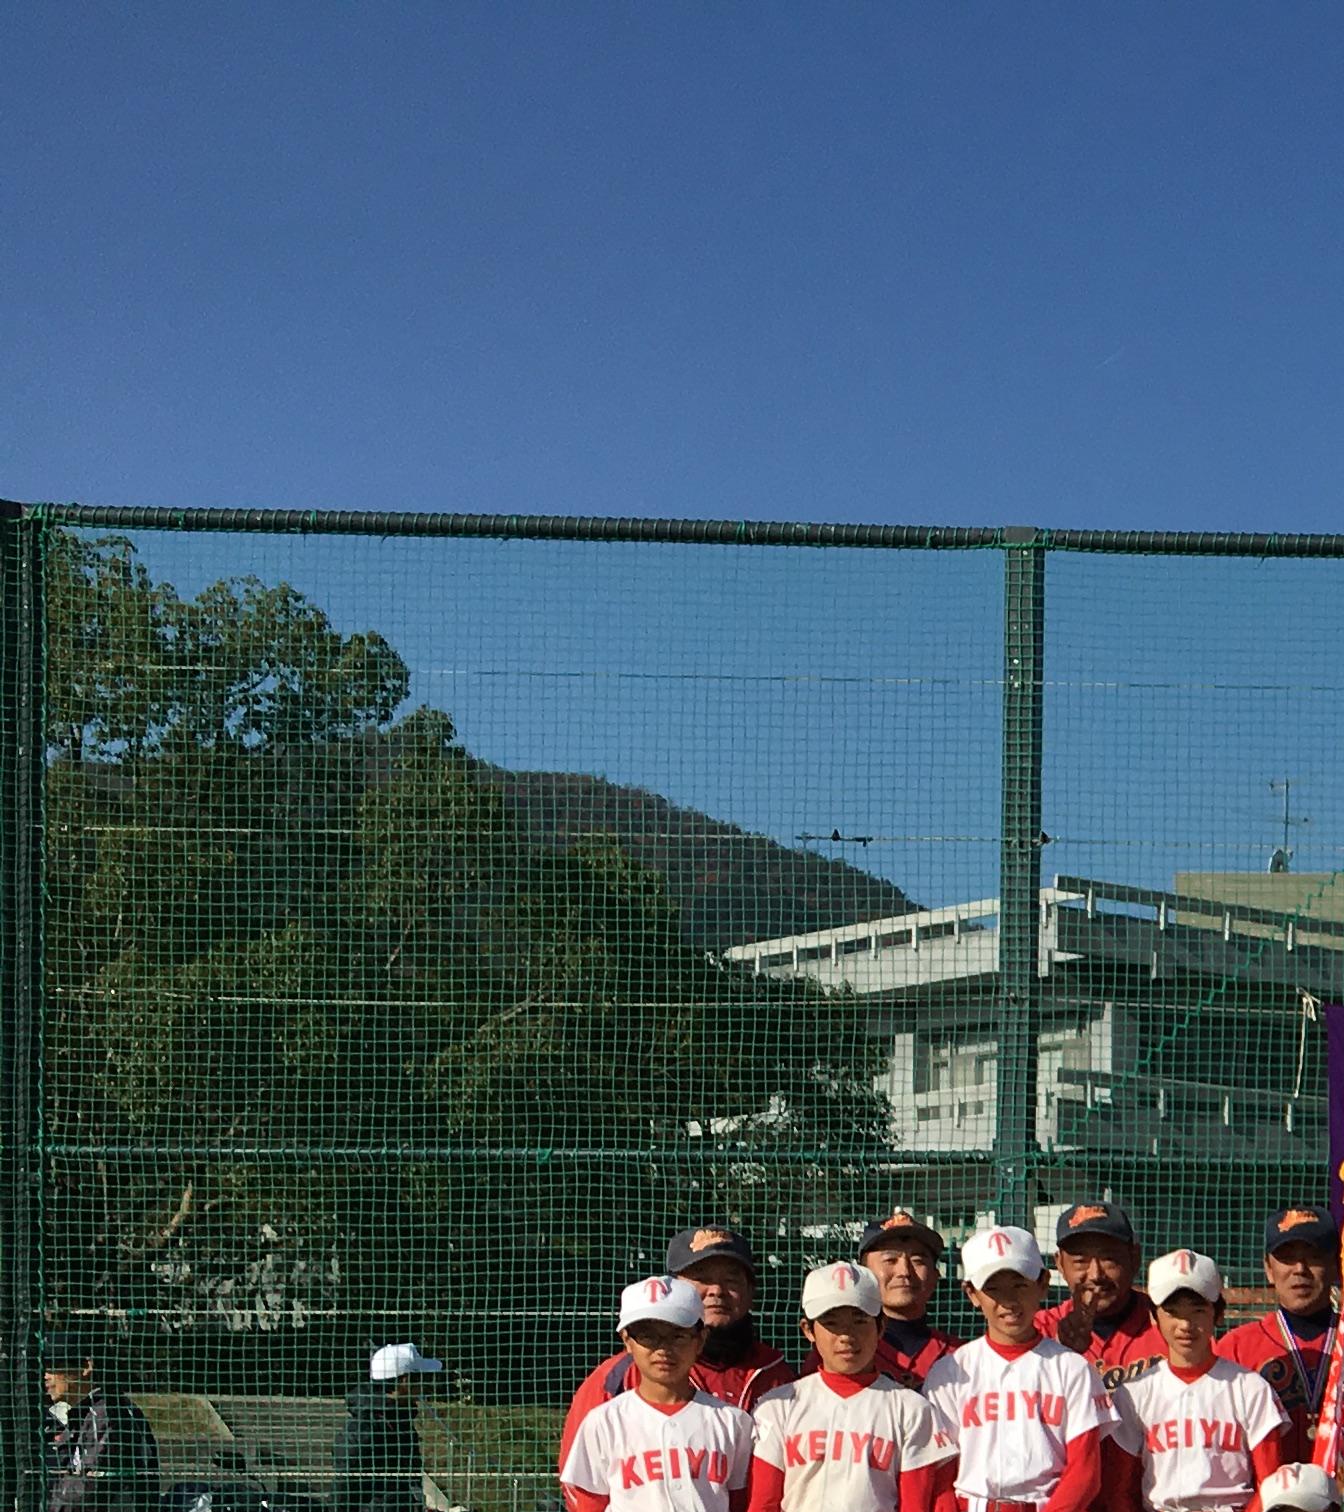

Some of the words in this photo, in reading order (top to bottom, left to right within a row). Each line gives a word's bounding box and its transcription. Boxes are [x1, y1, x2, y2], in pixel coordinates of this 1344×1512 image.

[962, 1391, 1064, 1429] KEIYU
[783, 1430, 896, 1472] KEIYU
[1146, 1418, 1242, 1453] KEIYU
[620, 1447, 728, 1490] KEIYU
